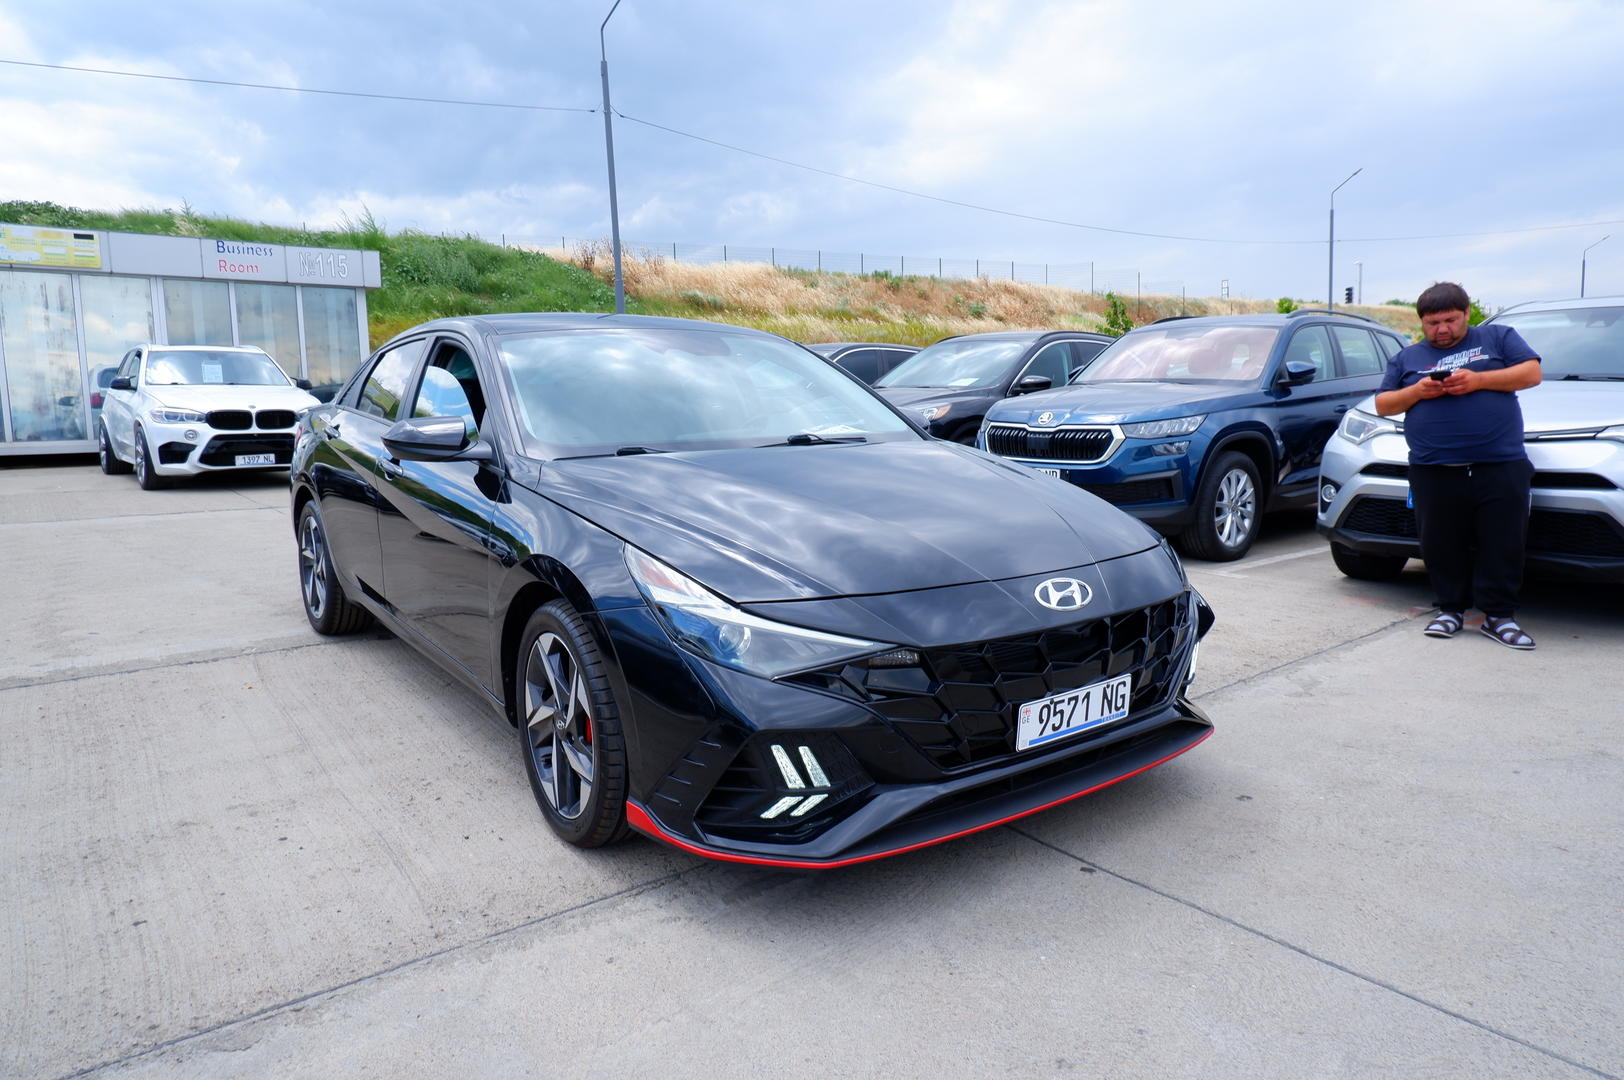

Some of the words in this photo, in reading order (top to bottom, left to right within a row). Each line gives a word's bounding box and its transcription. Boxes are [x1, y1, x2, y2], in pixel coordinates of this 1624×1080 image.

[216, 240, 273, 257] Business
[218, 259, 259, 274] Room
[1038, 691, 1091, 737] 9571
[1100, 681, 1127, 717] NG
